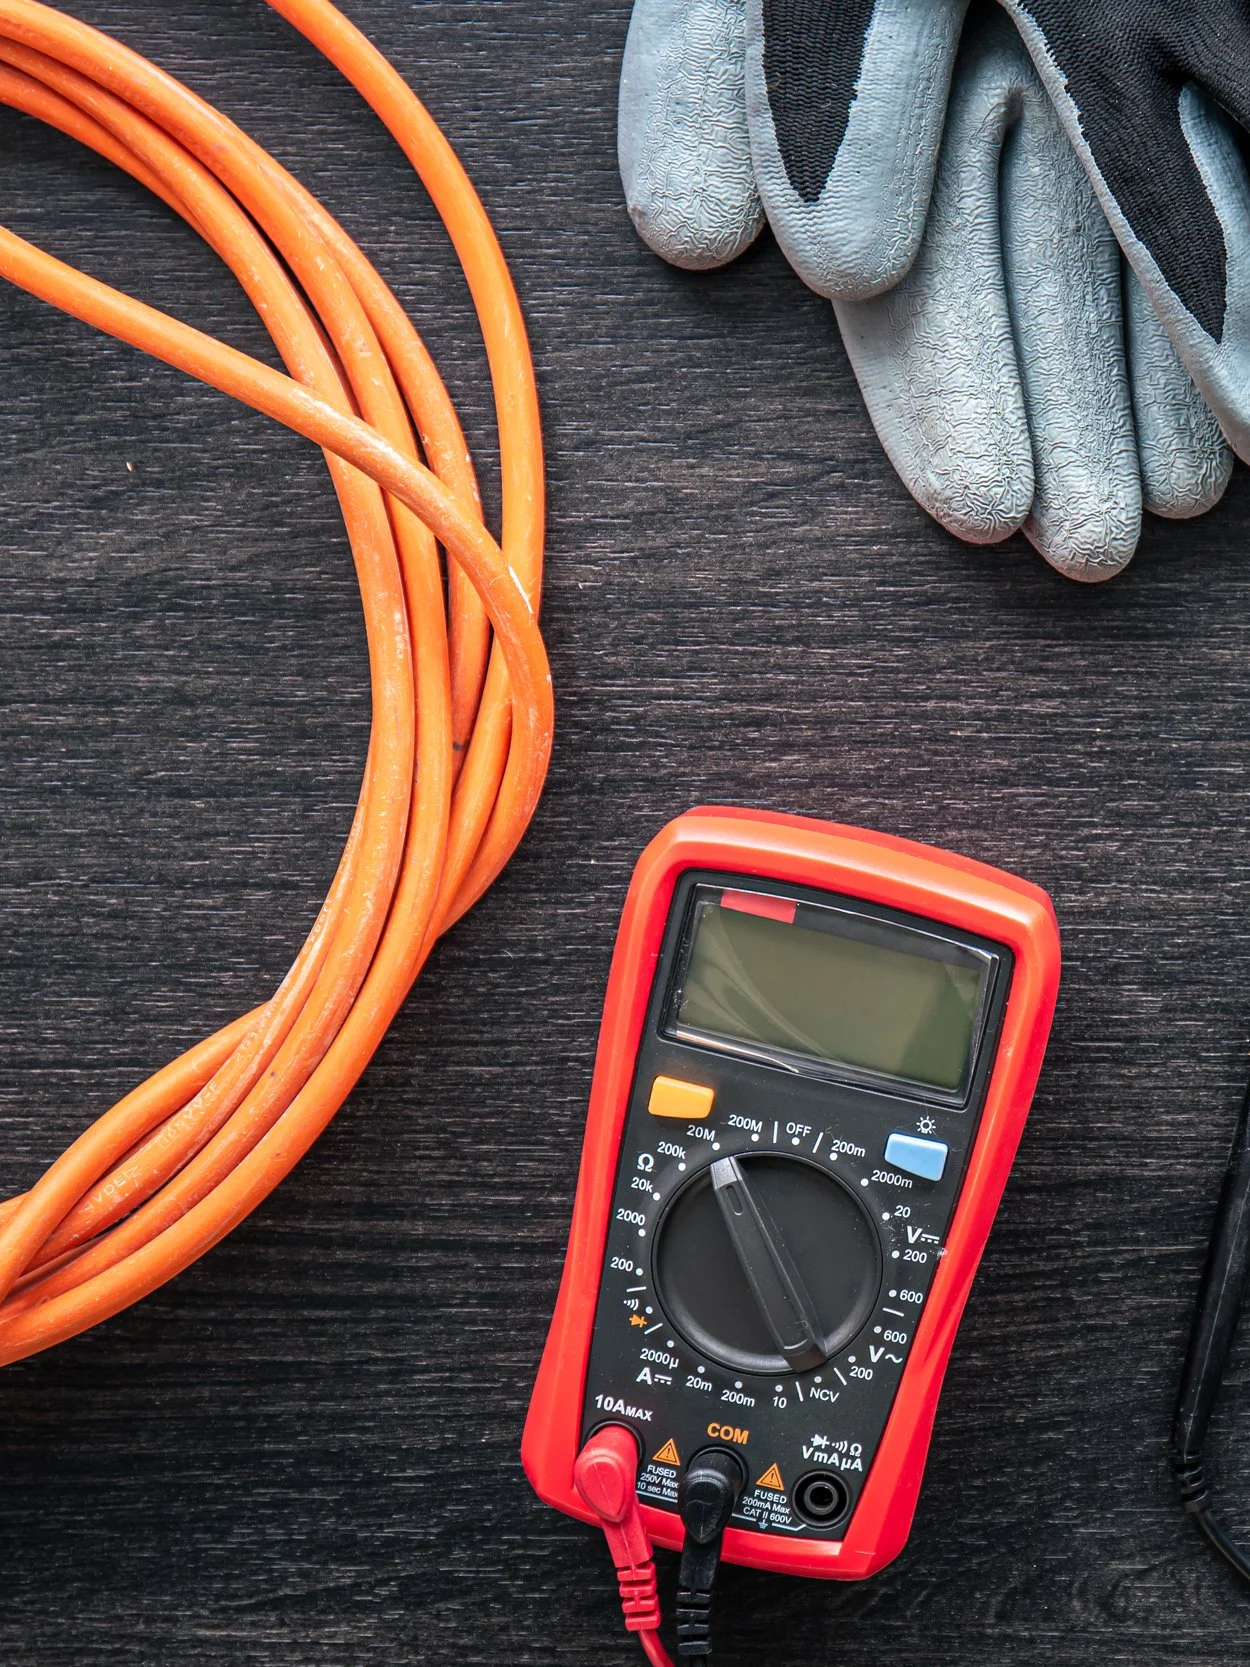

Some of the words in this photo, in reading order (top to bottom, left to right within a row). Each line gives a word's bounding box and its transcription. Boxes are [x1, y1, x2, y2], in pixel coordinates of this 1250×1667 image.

[728, 1114, 762, 1133] 200M
[786, 1122, 812, 1138] OFF
[686, 1125, 716, 1142] 20M
[657, 1141, 686, 1159] 200k
[831, 1140, 866, 1158] 200m
[631, 1177, 654, 1193] 20k
[871, 1169, 913, 1189] 2000m
[616, 1208, 646, 1226] 2000
[895, 1205, 911, 1218] 20
[610, 1256, 634, 1272] 200
[903, 1249, 927, 1264] 200
[900, 1290, 924, 1304] 600
[883, 1329, 907, 1344] 600
[849, 1366, 873, 1381] 200
[686, 1375, 712, 1392] 20m
[721, 1389, 756, 1408] 200m
[773, 1396, 787, 1409] 10
[809, 1387, 839, 1403] NCV
[707, 1422, 749, 1445] COM
[640, 1472, 661, 1484] 250V
[646, 1464, 677, 1478] FUSED
[637, 1481, 646, 1490] 10
[647, 1485, 661, 1494] sec
[753, 1490, 787, 1504] FUSED
[742, 1497, 772, 1510] 200mA
[772, 1504, 791, 1515] Max
[743, 1506, 761, 1518] CAT
[769, 1513, 793, 1524] 600V
